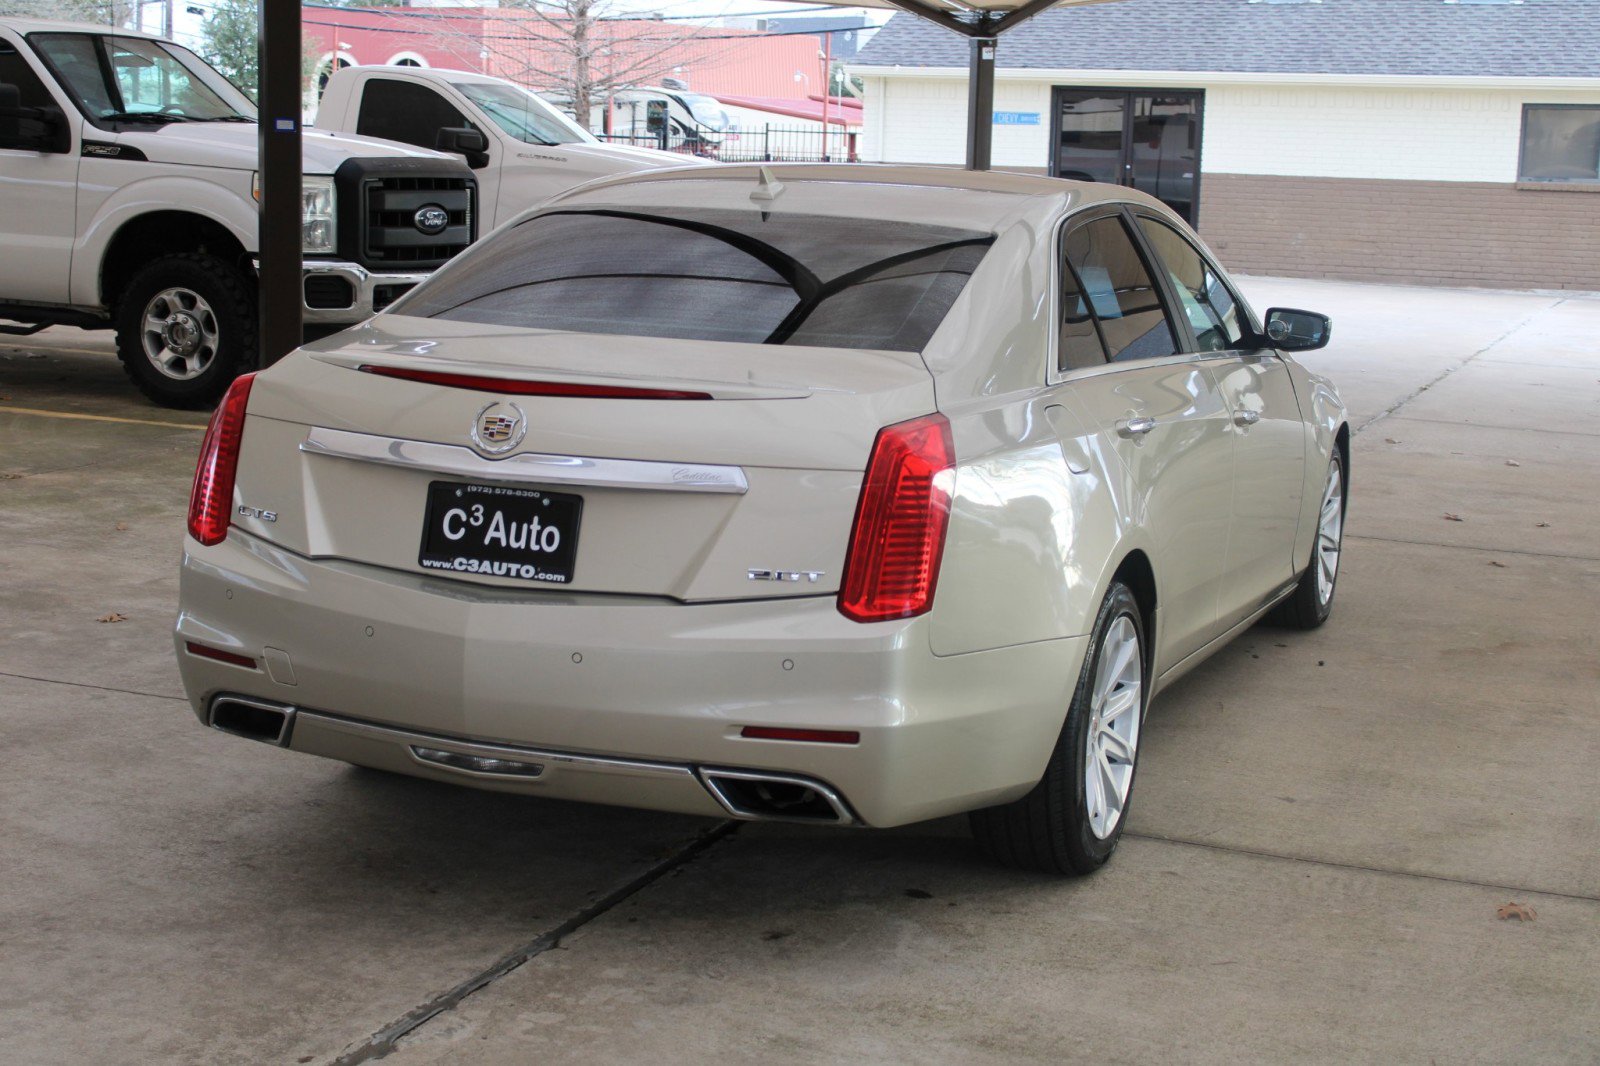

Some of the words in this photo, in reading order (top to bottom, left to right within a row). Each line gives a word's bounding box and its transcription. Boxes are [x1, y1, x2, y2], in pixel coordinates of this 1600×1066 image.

[467, 485, 492, 494] (972)
[239, 505, 278, 522] CTS
[484, 511, 560, 552] Auto
[422, 557, 565, 582] www.C3AUTO.com
